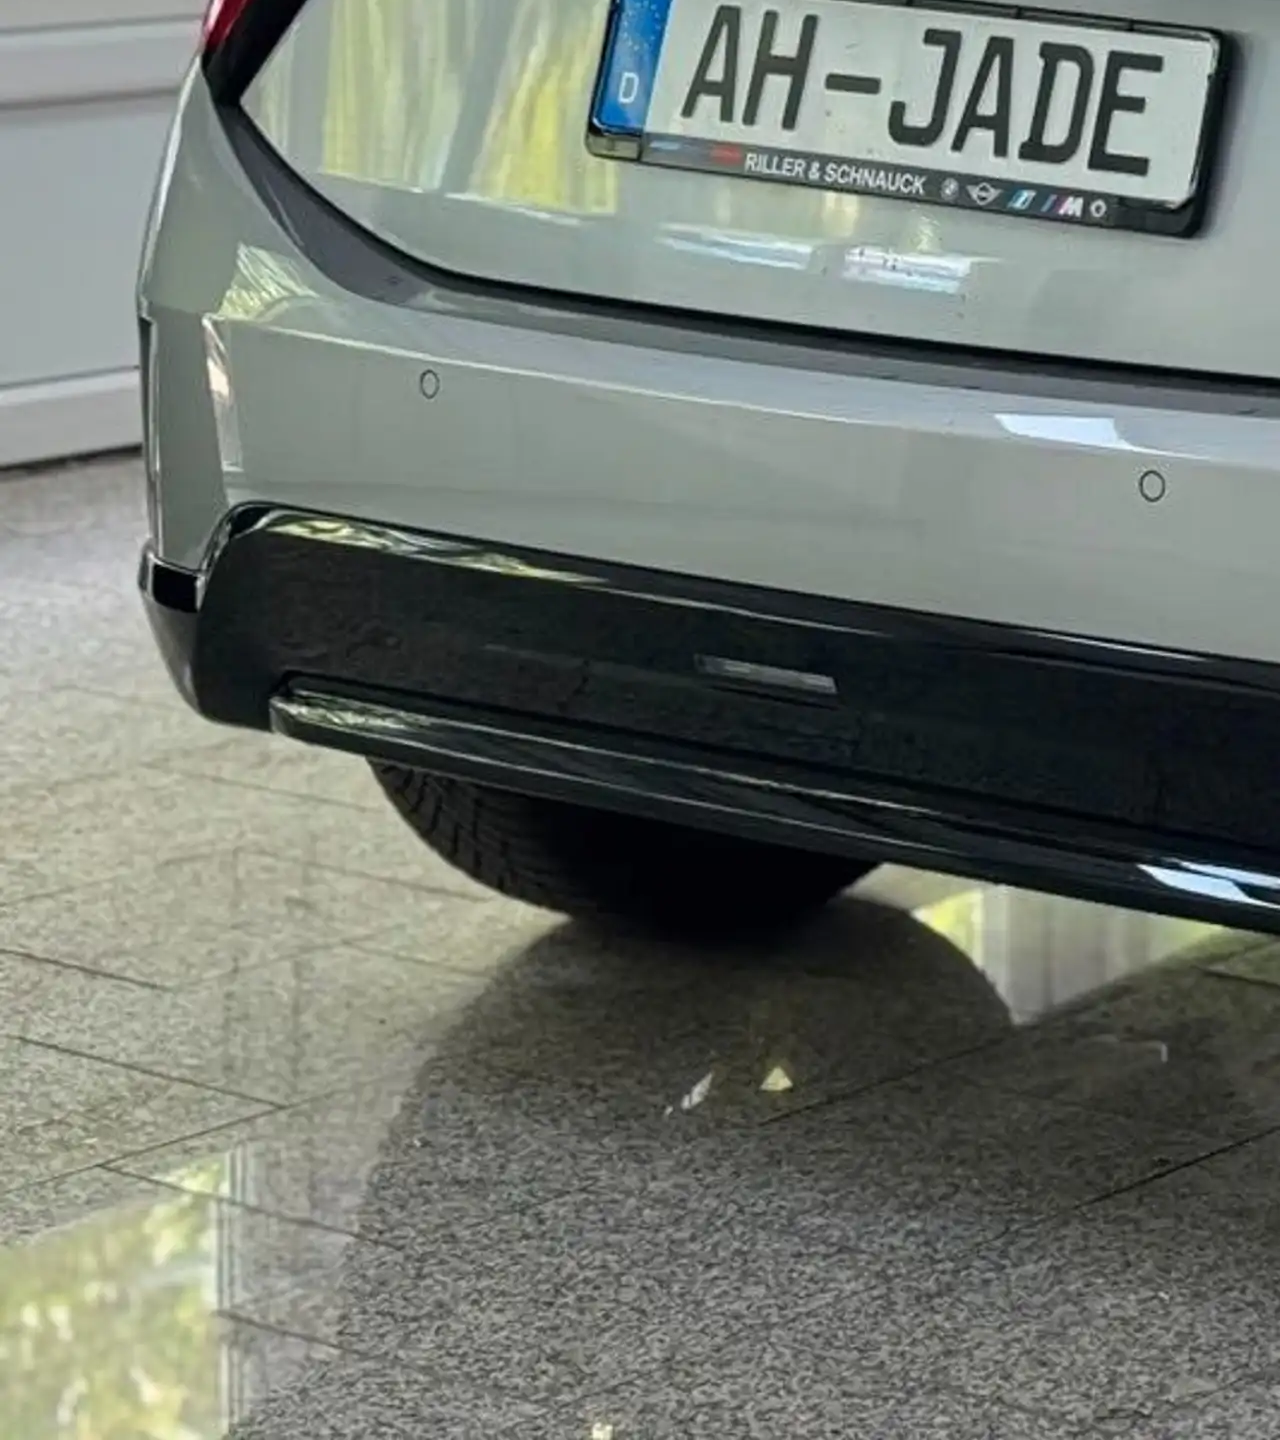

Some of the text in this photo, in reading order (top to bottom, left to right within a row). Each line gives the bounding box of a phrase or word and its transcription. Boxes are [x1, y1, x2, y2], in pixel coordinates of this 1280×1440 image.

[616, 71, 640, 105] D
[680, 5, 1164, 176] AH-JADE
[744, 153, 805, 178] RILLER
[807, 162, 820, 181] &
[824, 163, 927, 195] SCHNAUCK
